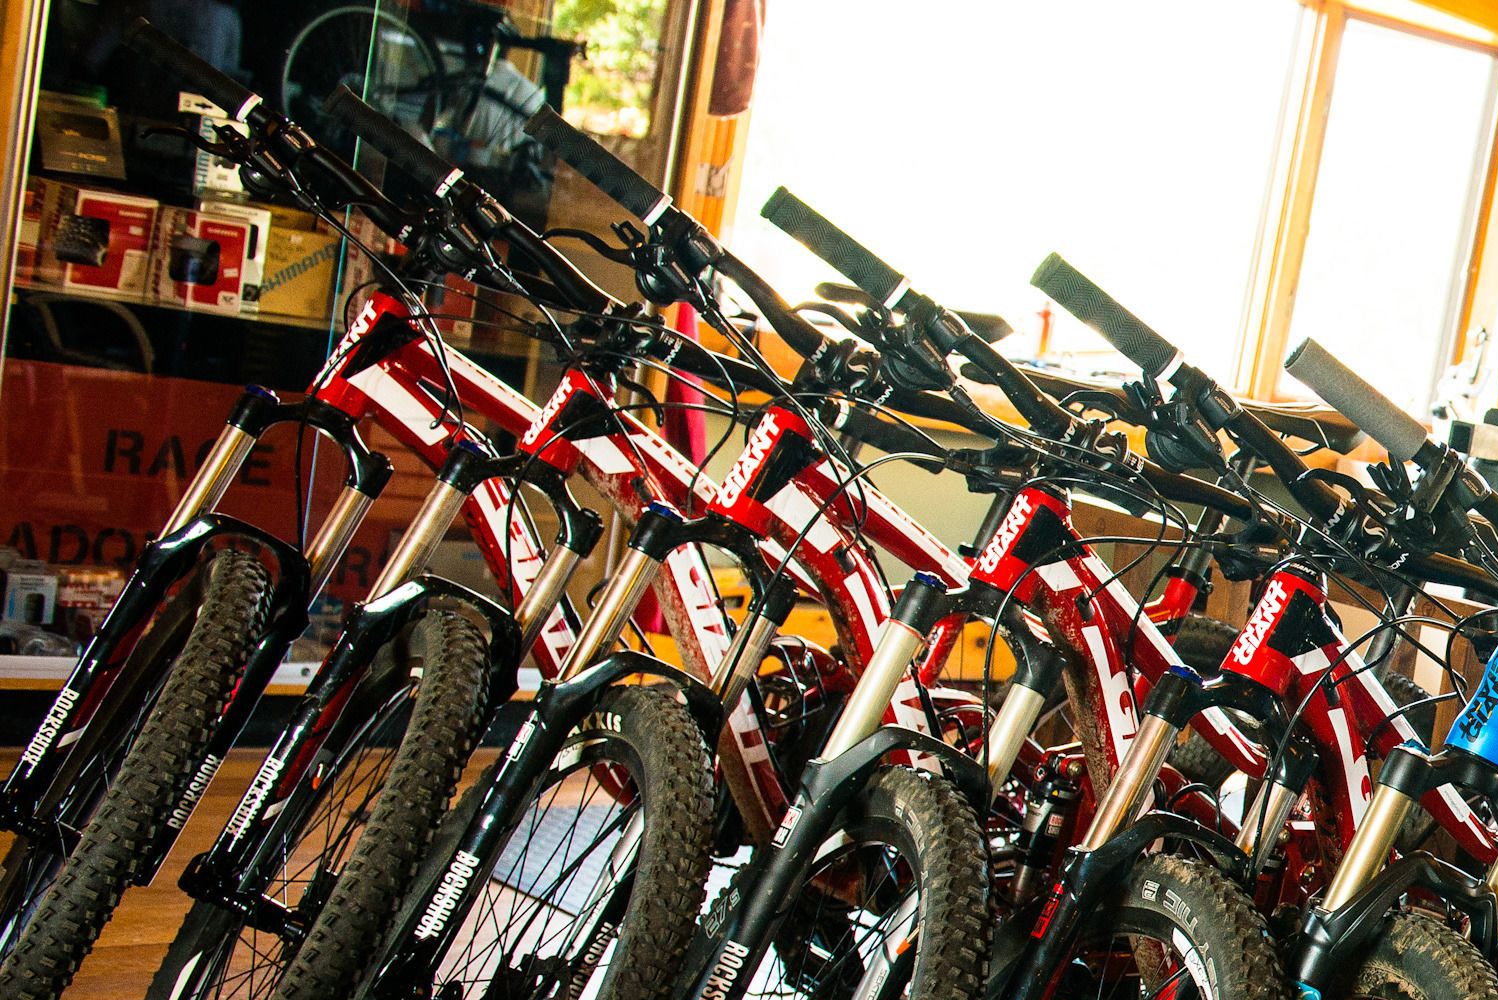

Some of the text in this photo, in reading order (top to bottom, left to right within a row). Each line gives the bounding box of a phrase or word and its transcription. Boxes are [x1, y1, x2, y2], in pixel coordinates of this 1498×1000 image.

[521, 376, 573, 446] GIANT
[716, 413, 780, 508] GIANT
[979, 494, 1032, 574] GIANT
[1233, 580, 1288, 666] GIANT
[21, 687, 80, 766] ROCKSHOX
[167, 753, 223, 830] ROCKSHOX
[225, 757, 285, 840] ROCKSHOX
[414, 850, 481, 938] ROCKSHOX
[704, 887, 742, 939] 27.5
